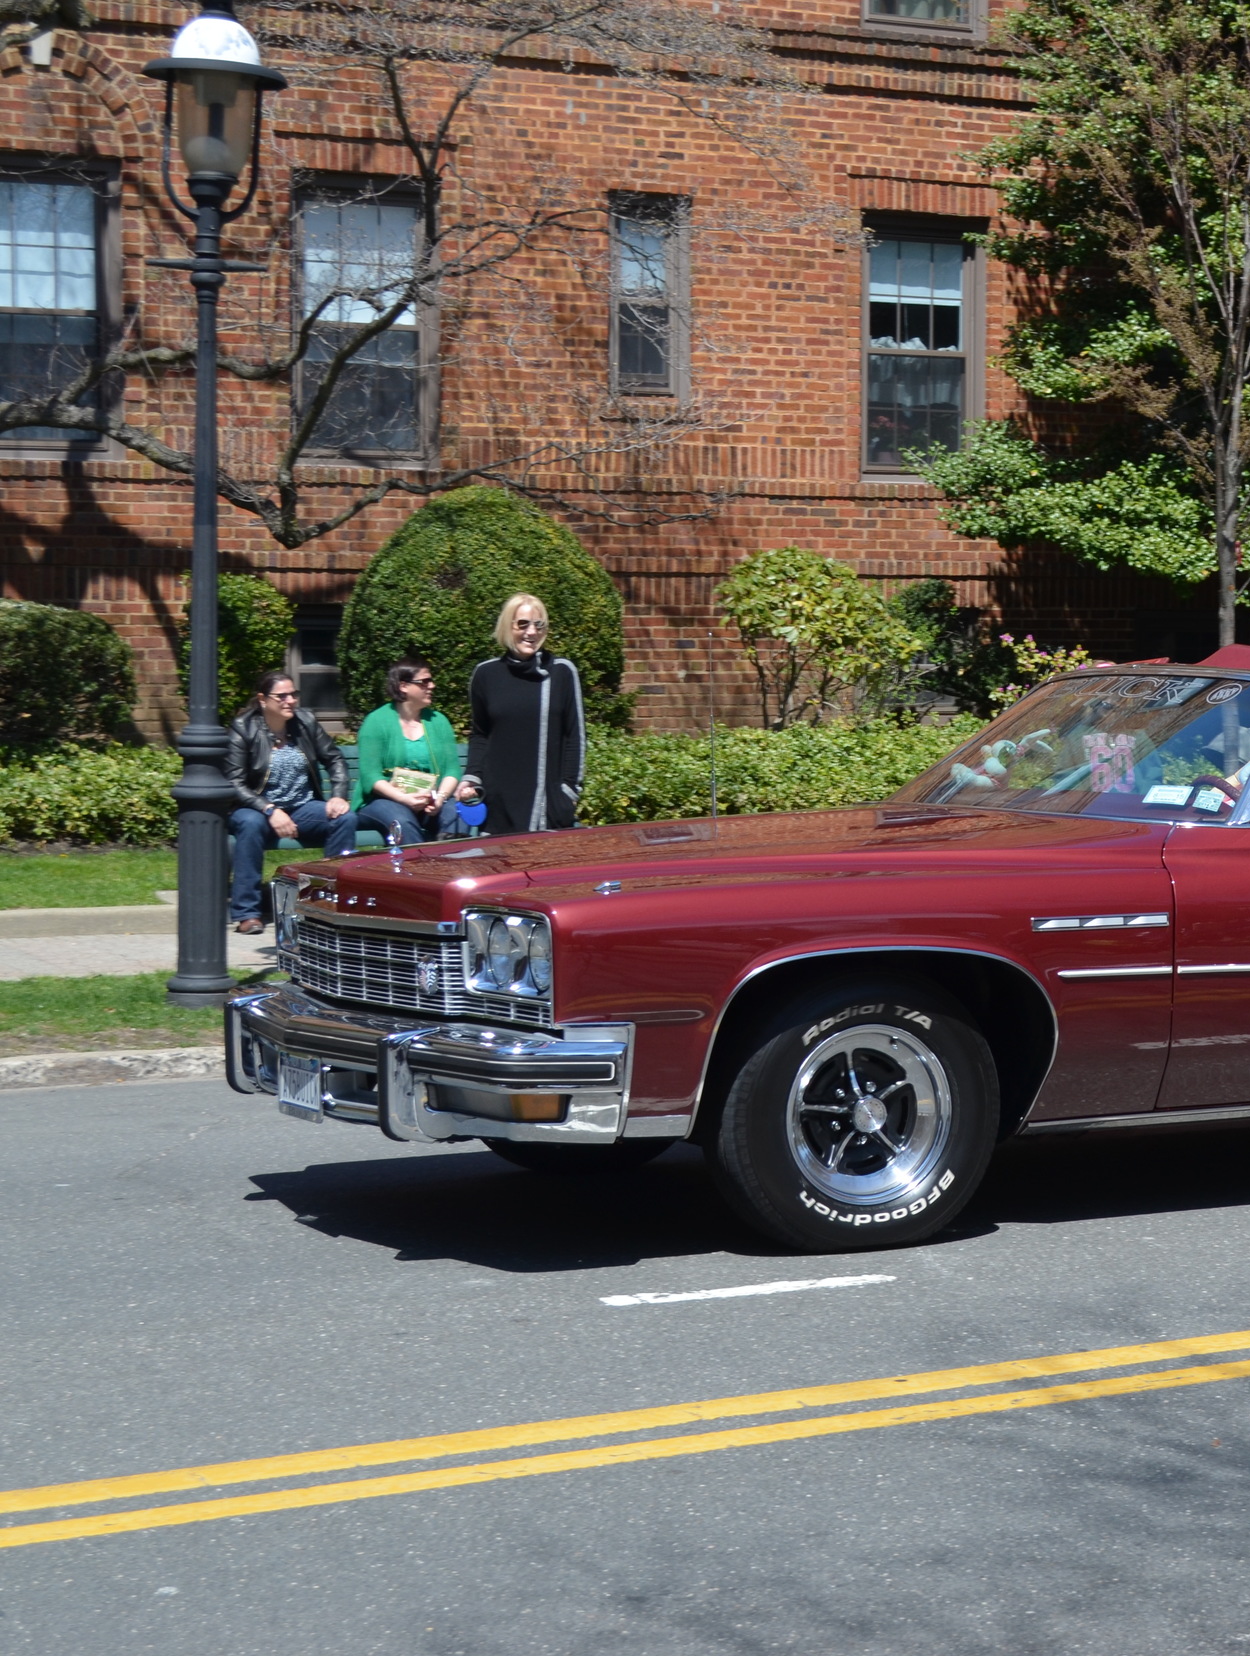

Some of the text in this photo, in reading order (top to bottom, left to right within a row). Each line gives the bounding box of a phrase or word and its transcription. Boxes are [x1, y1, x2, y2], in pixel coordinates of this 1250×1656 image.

[1090, 745, 1136, 793] 60
[802, 1003, 933, 1047] Radial T/A
[799, 1169, 956, 1227] BFGoodrich
